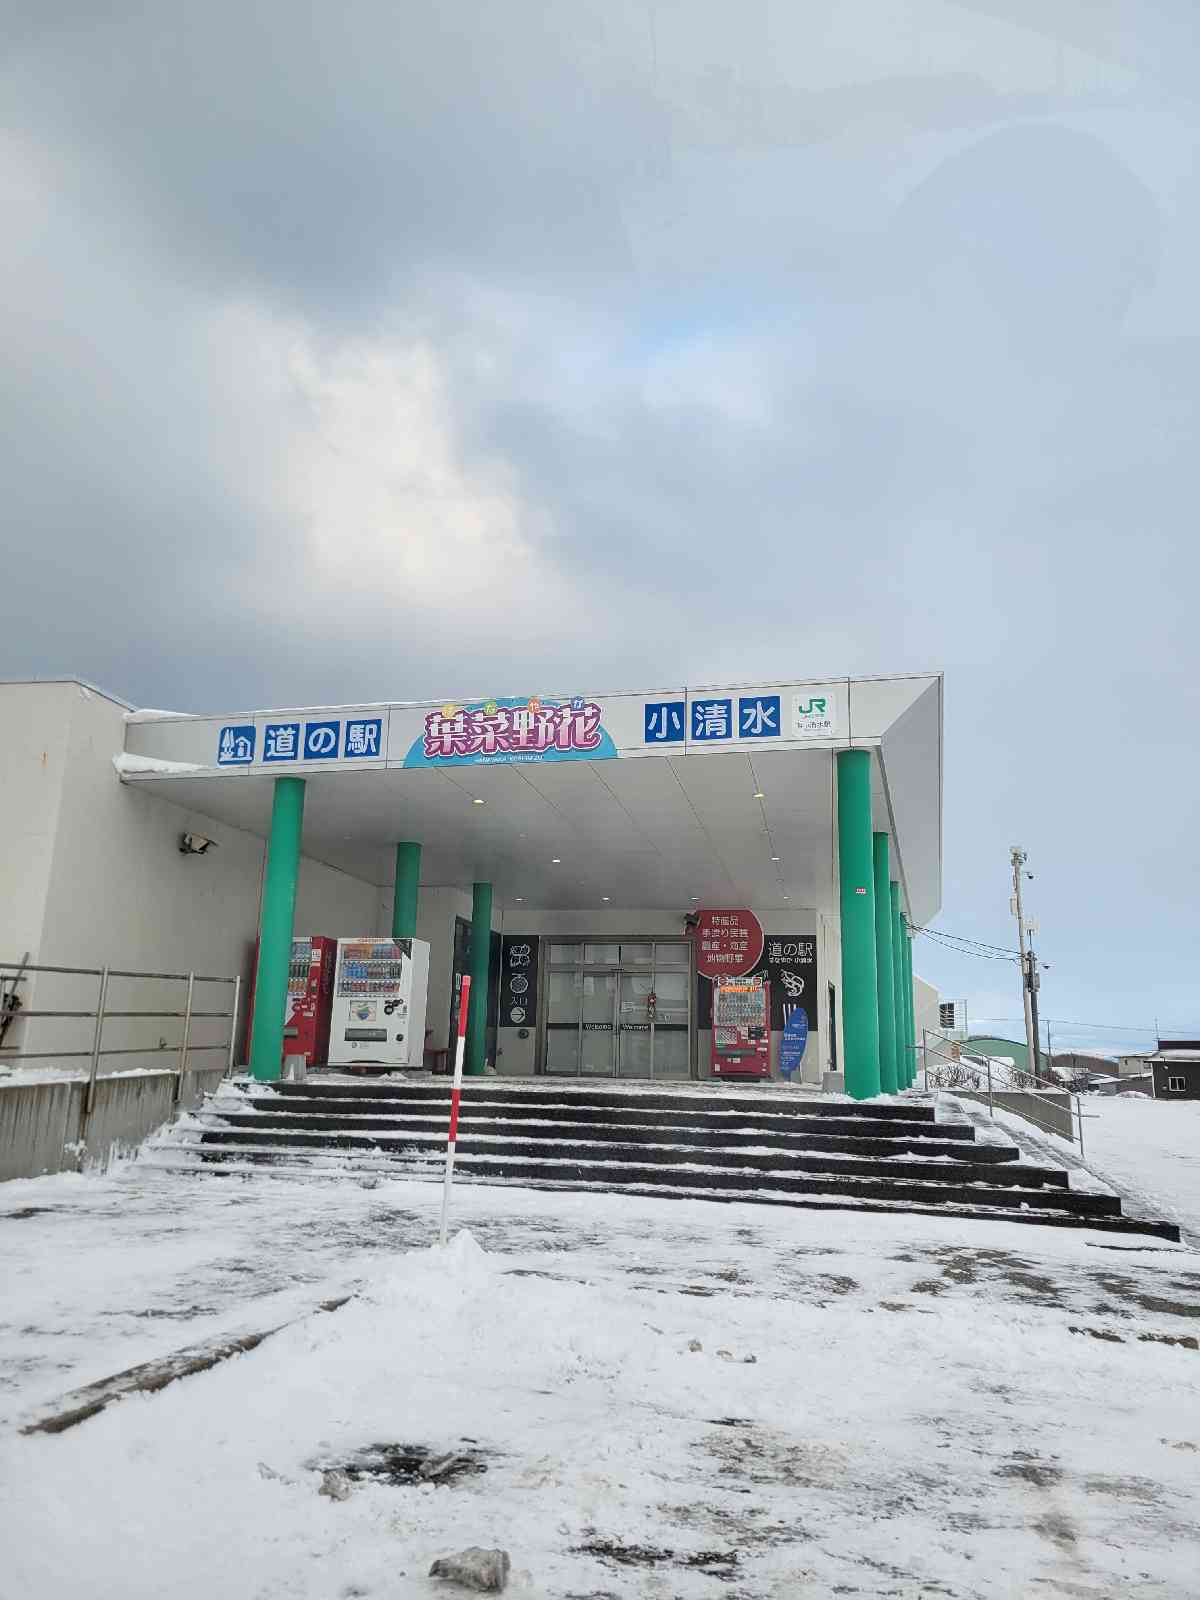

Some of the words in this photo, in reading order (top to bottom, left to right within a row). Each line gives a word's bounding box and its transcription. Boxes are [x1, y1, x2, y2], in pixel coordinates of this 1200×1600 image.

[798, 698, 826, 713] JR
[425, 704, 600, 757] 葉菜野花
[647, 701, 777, 739] 小清水
[266, 724, 377, 757] 道の駅
[768, 941, 813, 957] 道の駅
[511, 996, 528, 1006] 入口
